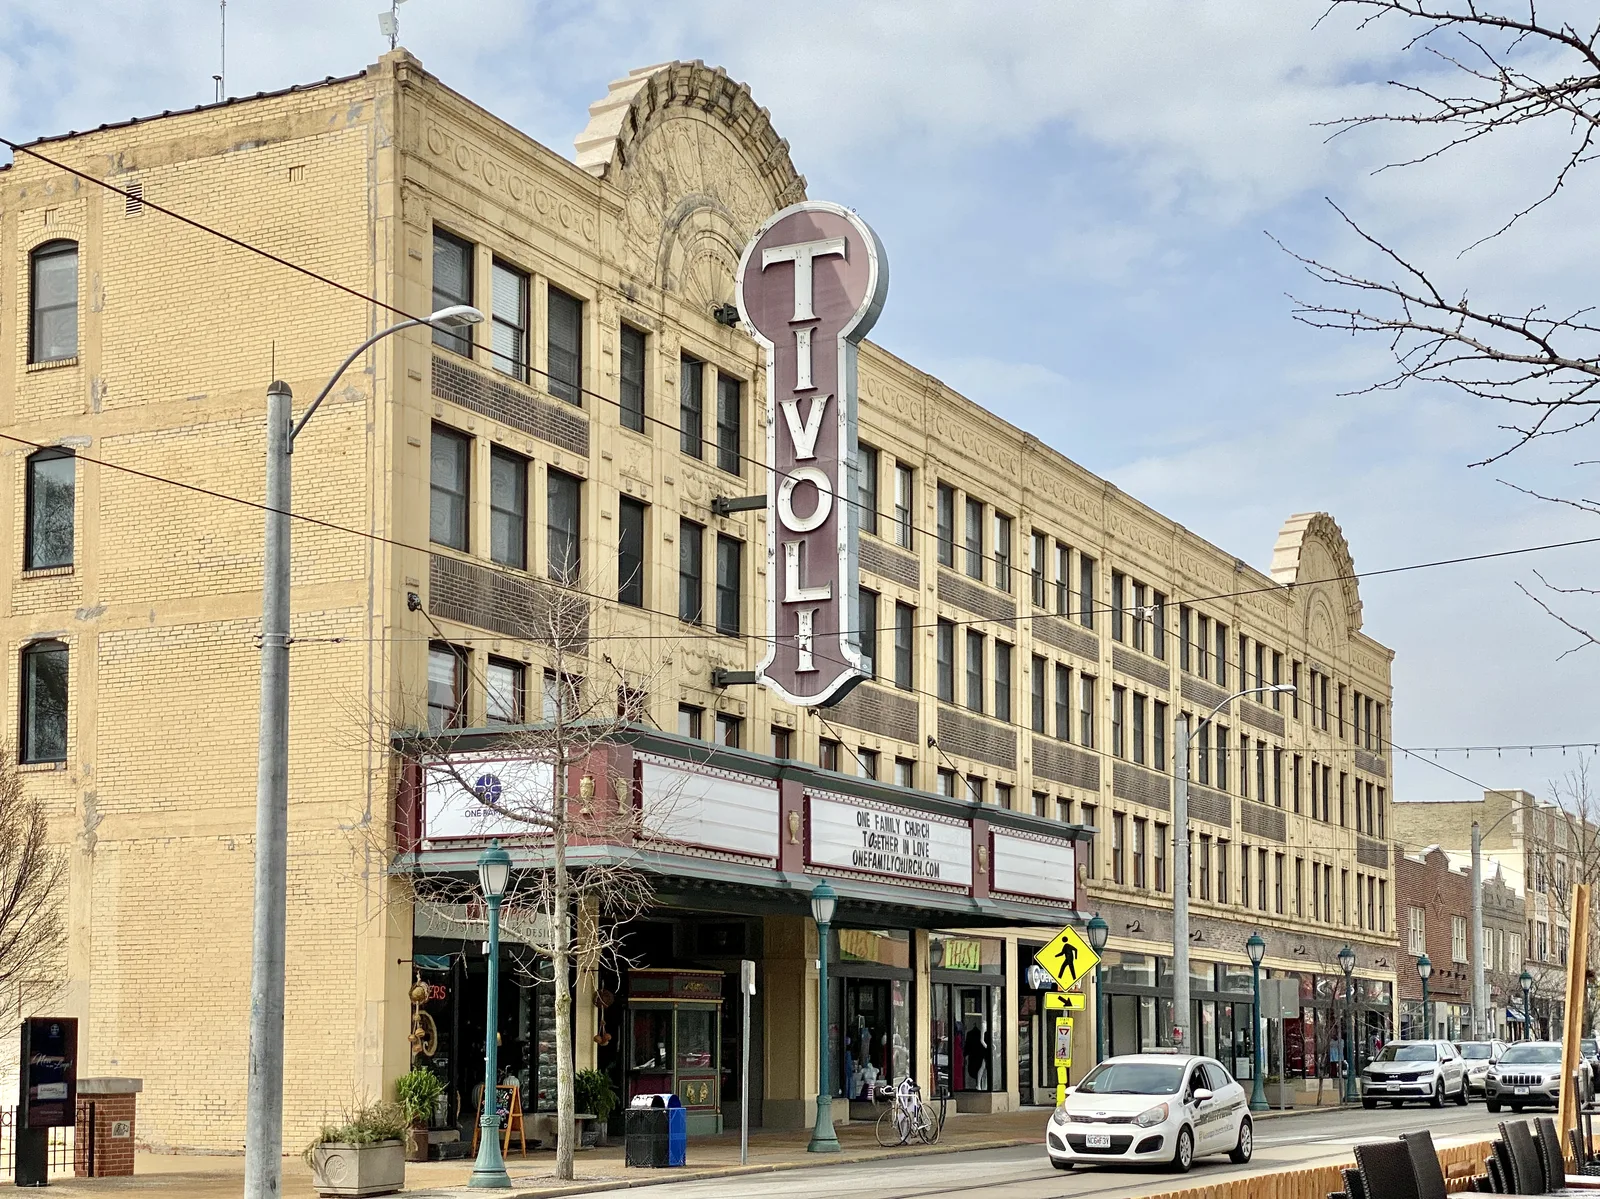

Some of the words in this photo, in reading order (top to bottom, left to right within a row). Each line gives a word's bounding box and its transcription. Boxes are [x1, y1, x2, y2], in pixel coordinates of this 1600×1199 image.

[761, 236, 847, 672] TIVOLI
[856, 811, 870, 828] ONE
[874, 814, 900, 834] FAMILY
[904, 820, 930, 839] CHURCH
[862, 830, 899, 853] TOGETHER
[903, 838, 909, 855] IN
[912, 840, 930, 858] LOVE
[852, 849, 940, 879] ONEFAMILYCHURCH.COM
